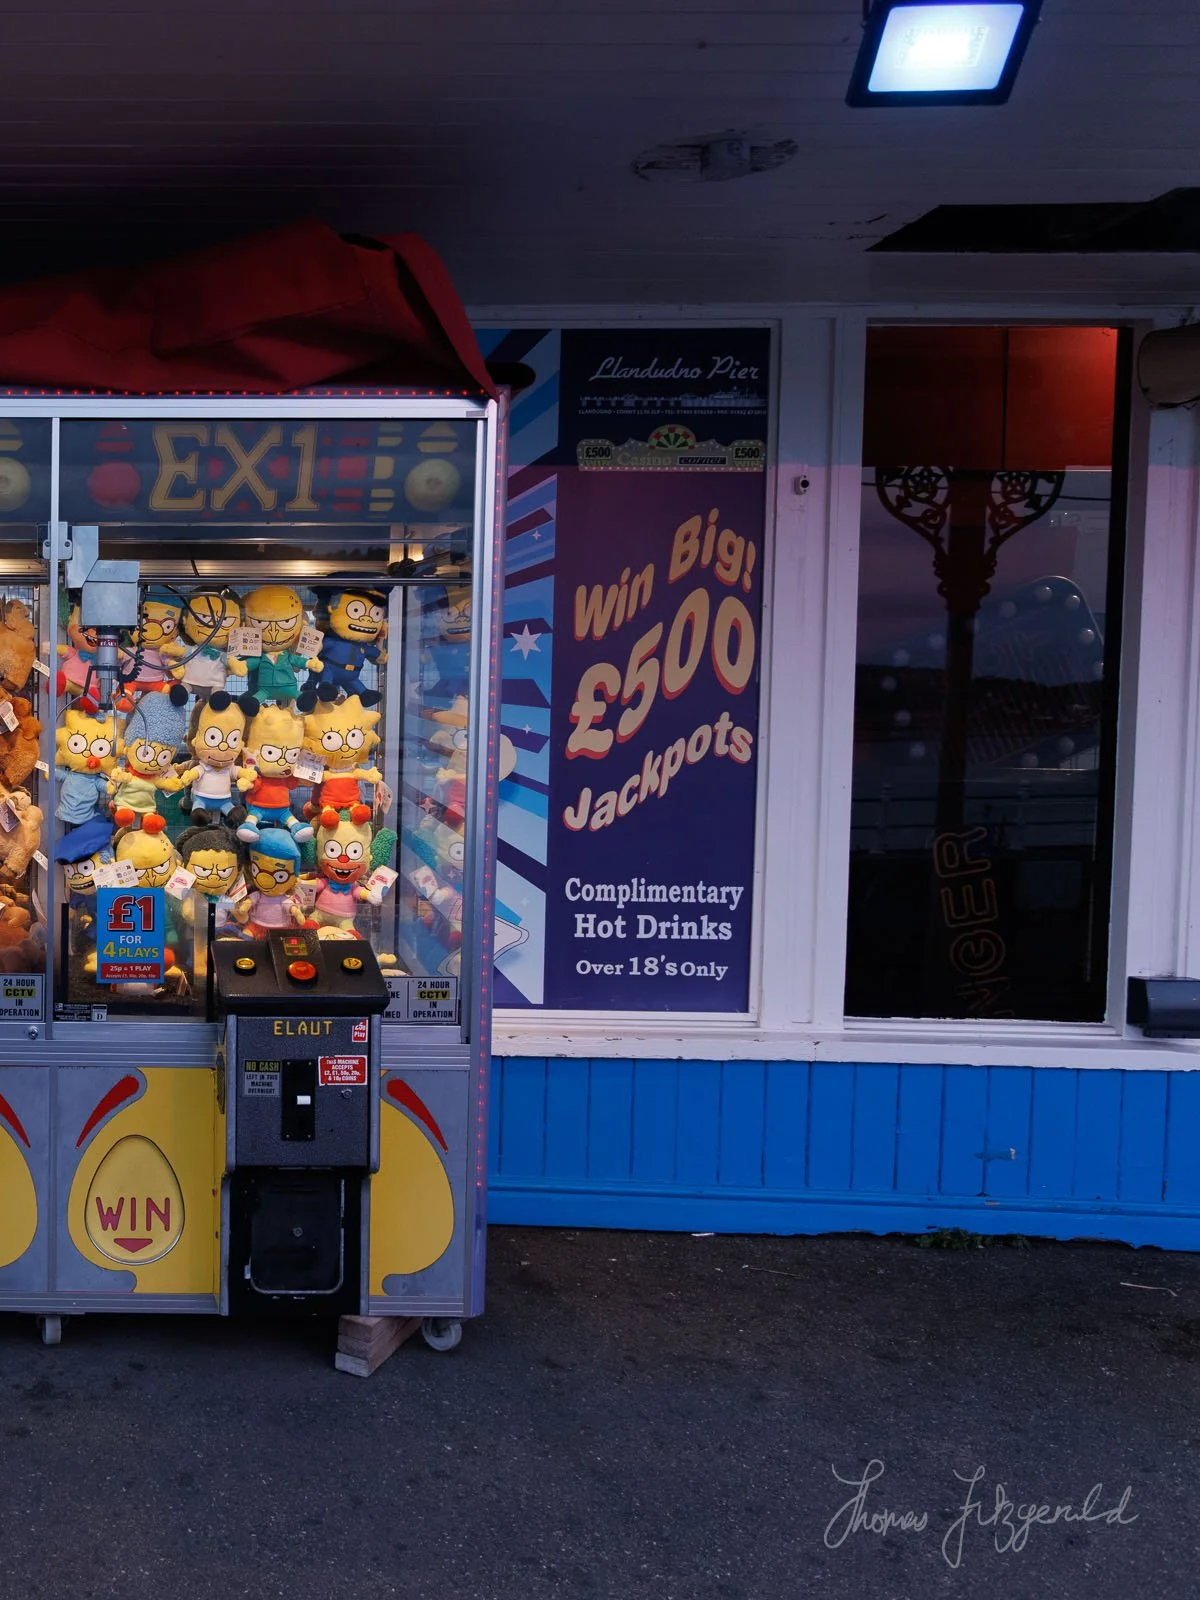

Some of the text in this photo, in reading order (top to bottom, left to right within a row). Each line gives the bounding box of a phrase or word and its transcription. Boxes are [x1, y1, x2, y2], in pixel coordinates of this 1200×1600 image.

[588, 354, 761, 381] Llandudno Pier
[585, 446, 611, 459] £500
[617, 452, 672, 466] Casino
[734, 448, 760, 460] £500
[148, 421, 321, 512] EX1
[574, 507, 756, 641] Win Big!
[564, 587, 756, 760] £500
[562, 711, 754, 832] Jackpots
[565, 877, 745, 911] Complimentary
[107, 894, 154, 931] £1
[574, 913, 733, 940] Hot Drinks
[119, 935, 142, 944] FOR
[103, 941, 159, 958] 4 PLAYS
[576, 954, 729, 981] Over 18's Only
[3, 978, 36, 987] 24 HOUR
[417, 981, 450, 989] 24 HOUR
[5, 988, 34, 997] CCTV
[419, 990, 448, 999] CCTV
[15, 999, 23, 1007] IN
[429, 1001, 438, 1009] IN
[412, 1010, 453, 1018] OPERATION
[273, 1020, 333, 1036] ELAUT
[246, 1061, 280, 1072] NO CASH
[95, 1196, 171, 1232] WIN
